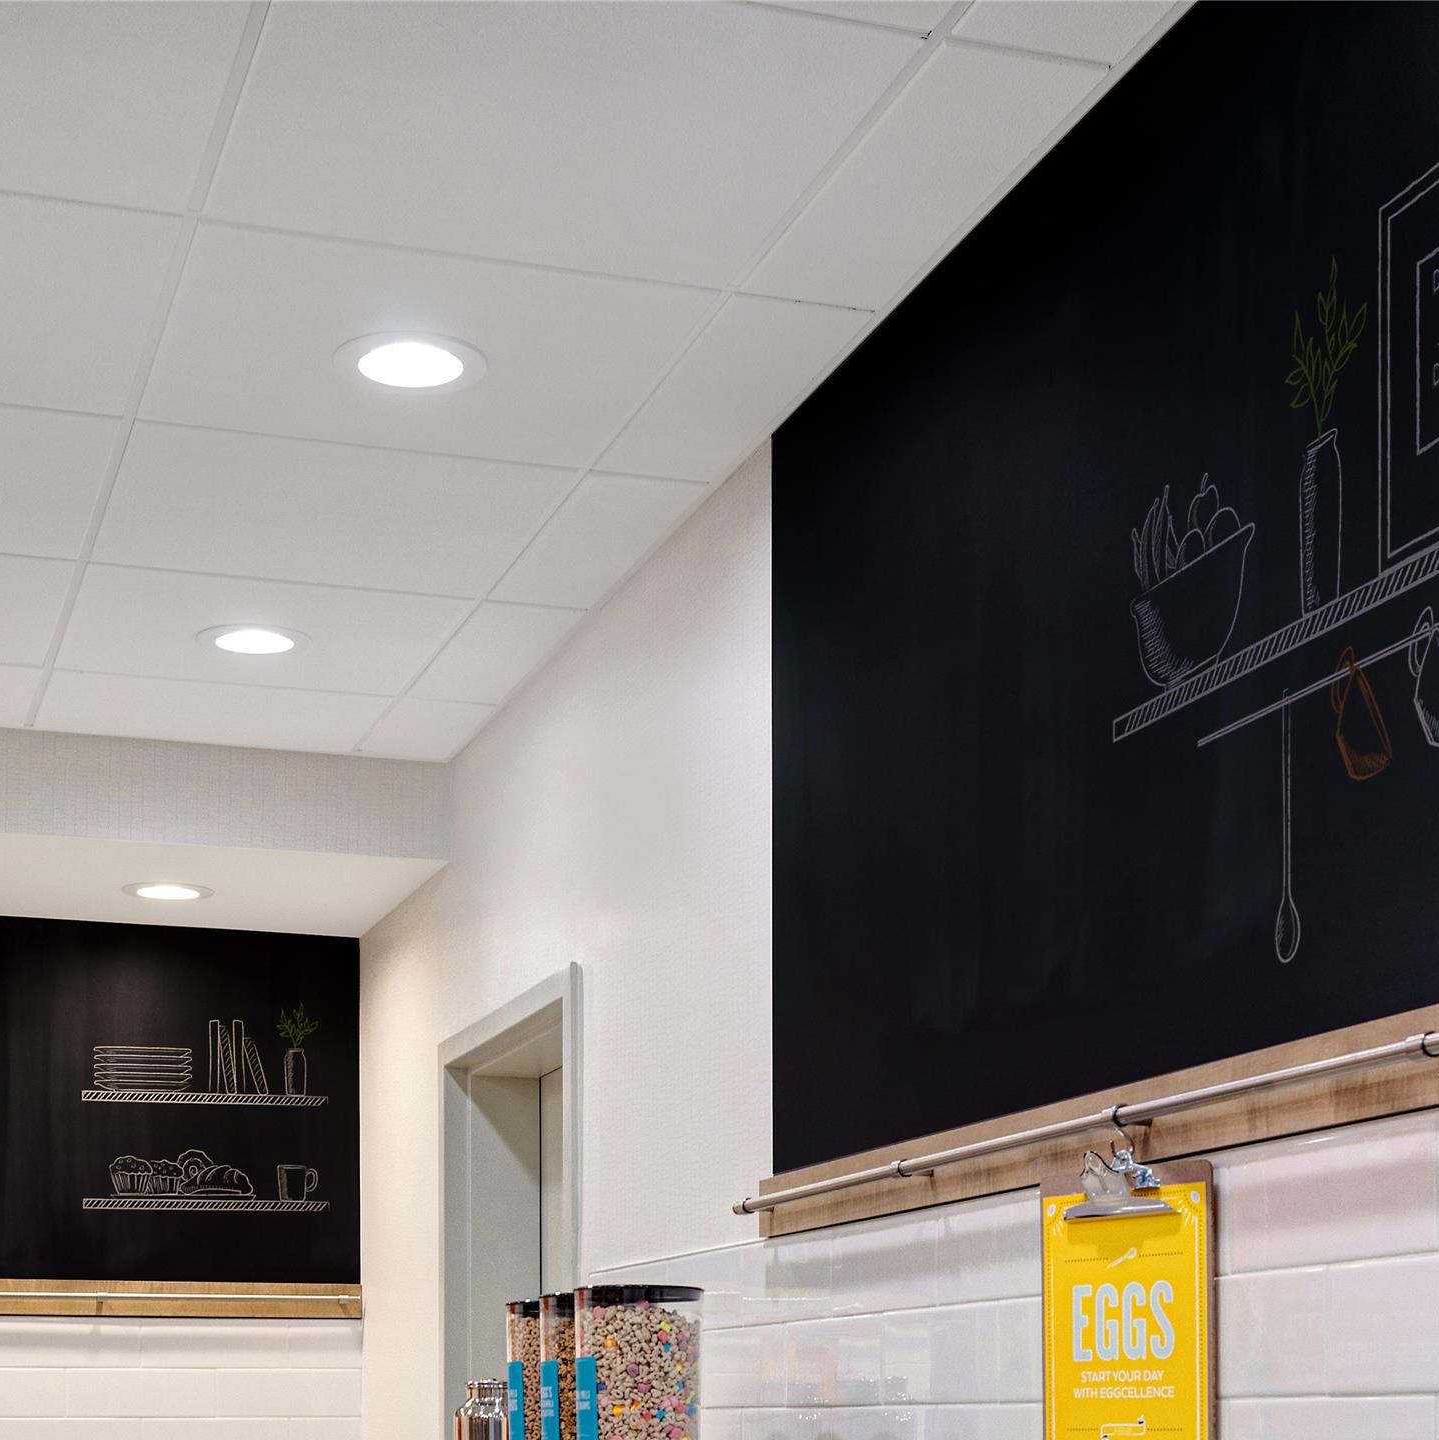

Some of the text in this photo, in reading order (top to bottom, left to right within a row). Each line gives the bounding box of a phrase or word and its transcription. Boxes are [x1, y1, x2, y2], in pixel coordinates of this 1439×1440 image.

[1072, 1280, 1175, 1362] EGGS
[1081, 1369, 1165, 1383] START YOUR DAY
[1073, 1385, 1175, 1399] WITH EGGCELLENCE
